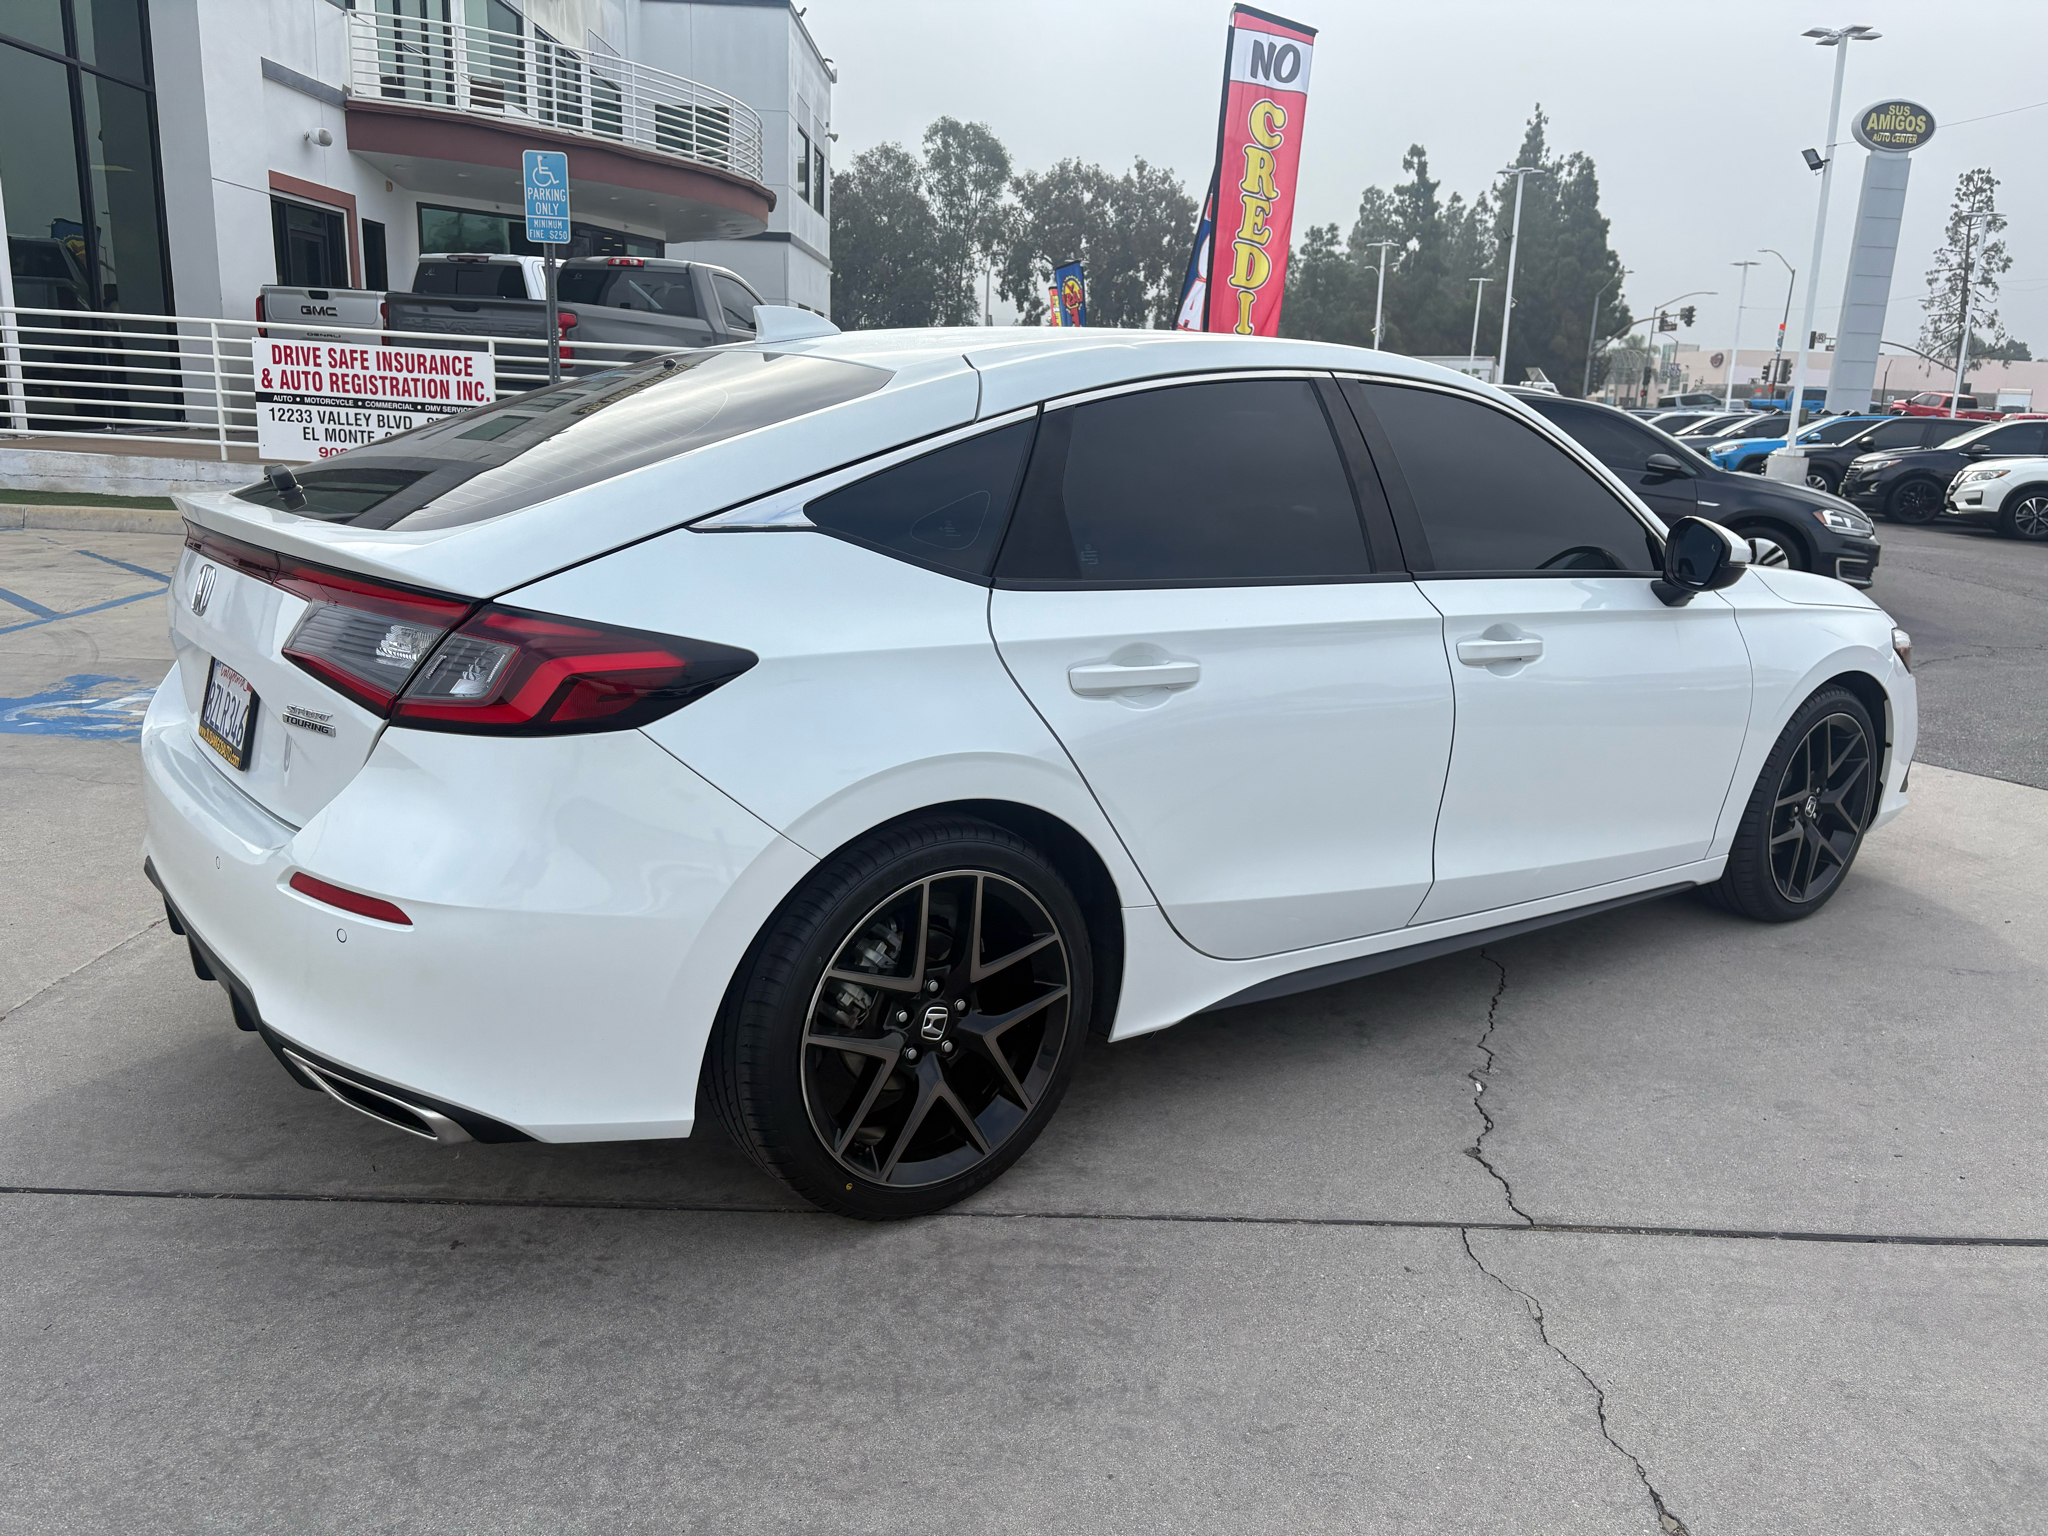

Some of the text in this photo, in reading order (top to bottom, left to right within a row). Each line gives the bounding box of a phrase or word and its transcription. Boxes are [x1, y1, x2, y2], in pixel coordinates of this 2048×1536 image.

[1250, 39, 1301, 83] NO
[1888, 105, 1910, 116] SUS
[1866, 112, 1927, 133] AMIGOS
[1872, 133, 1918, 144] AUTO CENTER
[527, 187, 566, 202] PARKING
[535, 202, 559, 215] ONLY
[533, 219, 562, 229] MINIMUM
[529, 229, 568, 240] FINE $250
[301, 305, 338, 317] GMC
[271, 344, 473, 377] DRIVE SAFE INSURANCE
[261, 368, 490, 402] & AUTO REGISTRATION INC.
[273, 394, 293, 402] AUTO
[304, 396, 354, 407] MOTORCYCLE
[365, 400, 414, 411] COMMERCIAL
[425, 404, 441, 412] DMV
[268, 407, 313, 424] 12233
[317, 410, 371, 427] VALLEY
[377, 414, 412, 430] BLVD
[303, 426, 319, 441] EL
[204, 681, 249, 748] 8ZLR346
[286, 704, 333, 722] SPORT
[286, 715, 329, 734] TOURING
